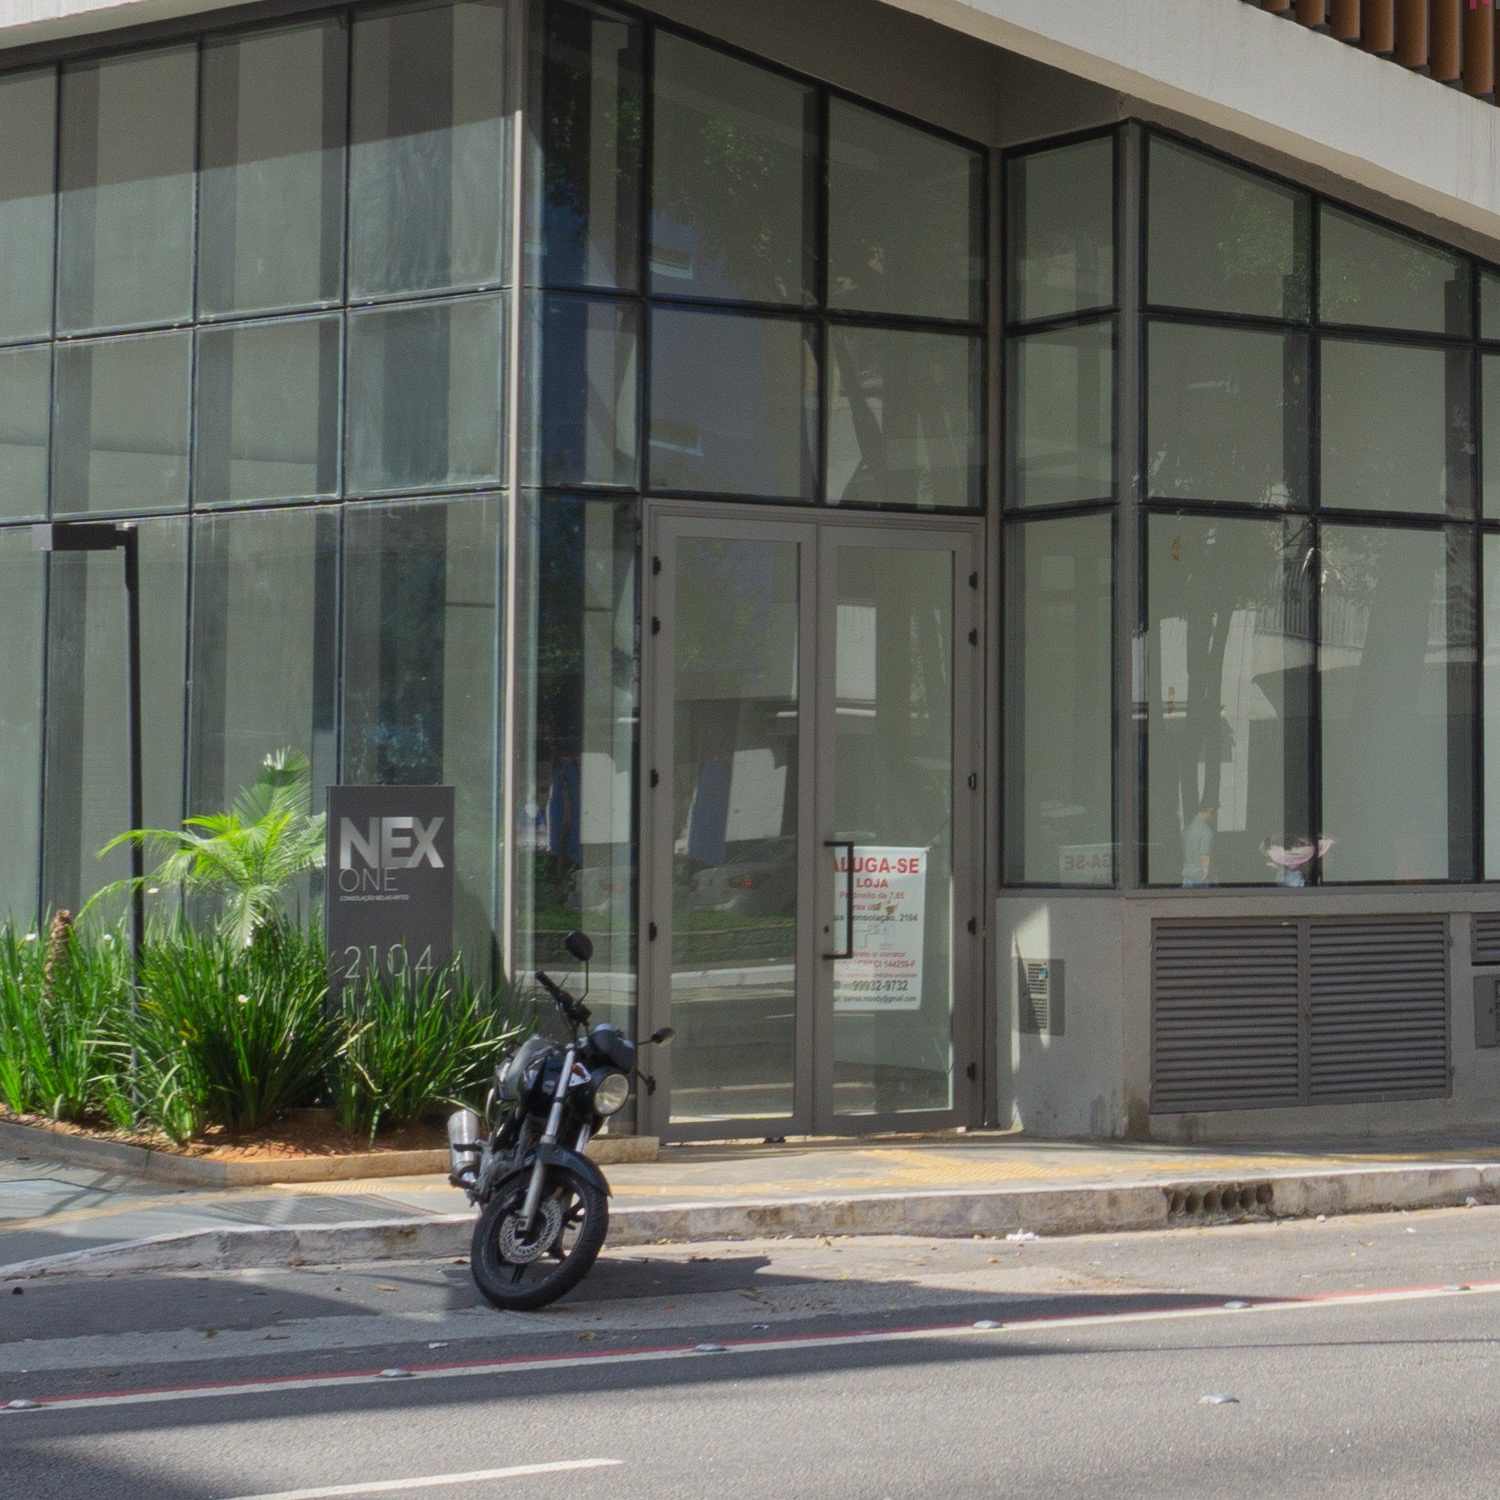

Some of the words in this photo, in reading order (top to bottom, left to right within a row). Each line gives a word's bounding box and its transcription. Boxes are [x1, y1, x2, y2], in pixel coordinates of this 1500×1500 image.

[339, 816, 445, 869] NEX
[338, 867, 399, 892] ONE
[856, 878, 889, 888] LOJA
[852, 912, 898, 923] onsolação,
[343, 944, 434, 979] 2104
